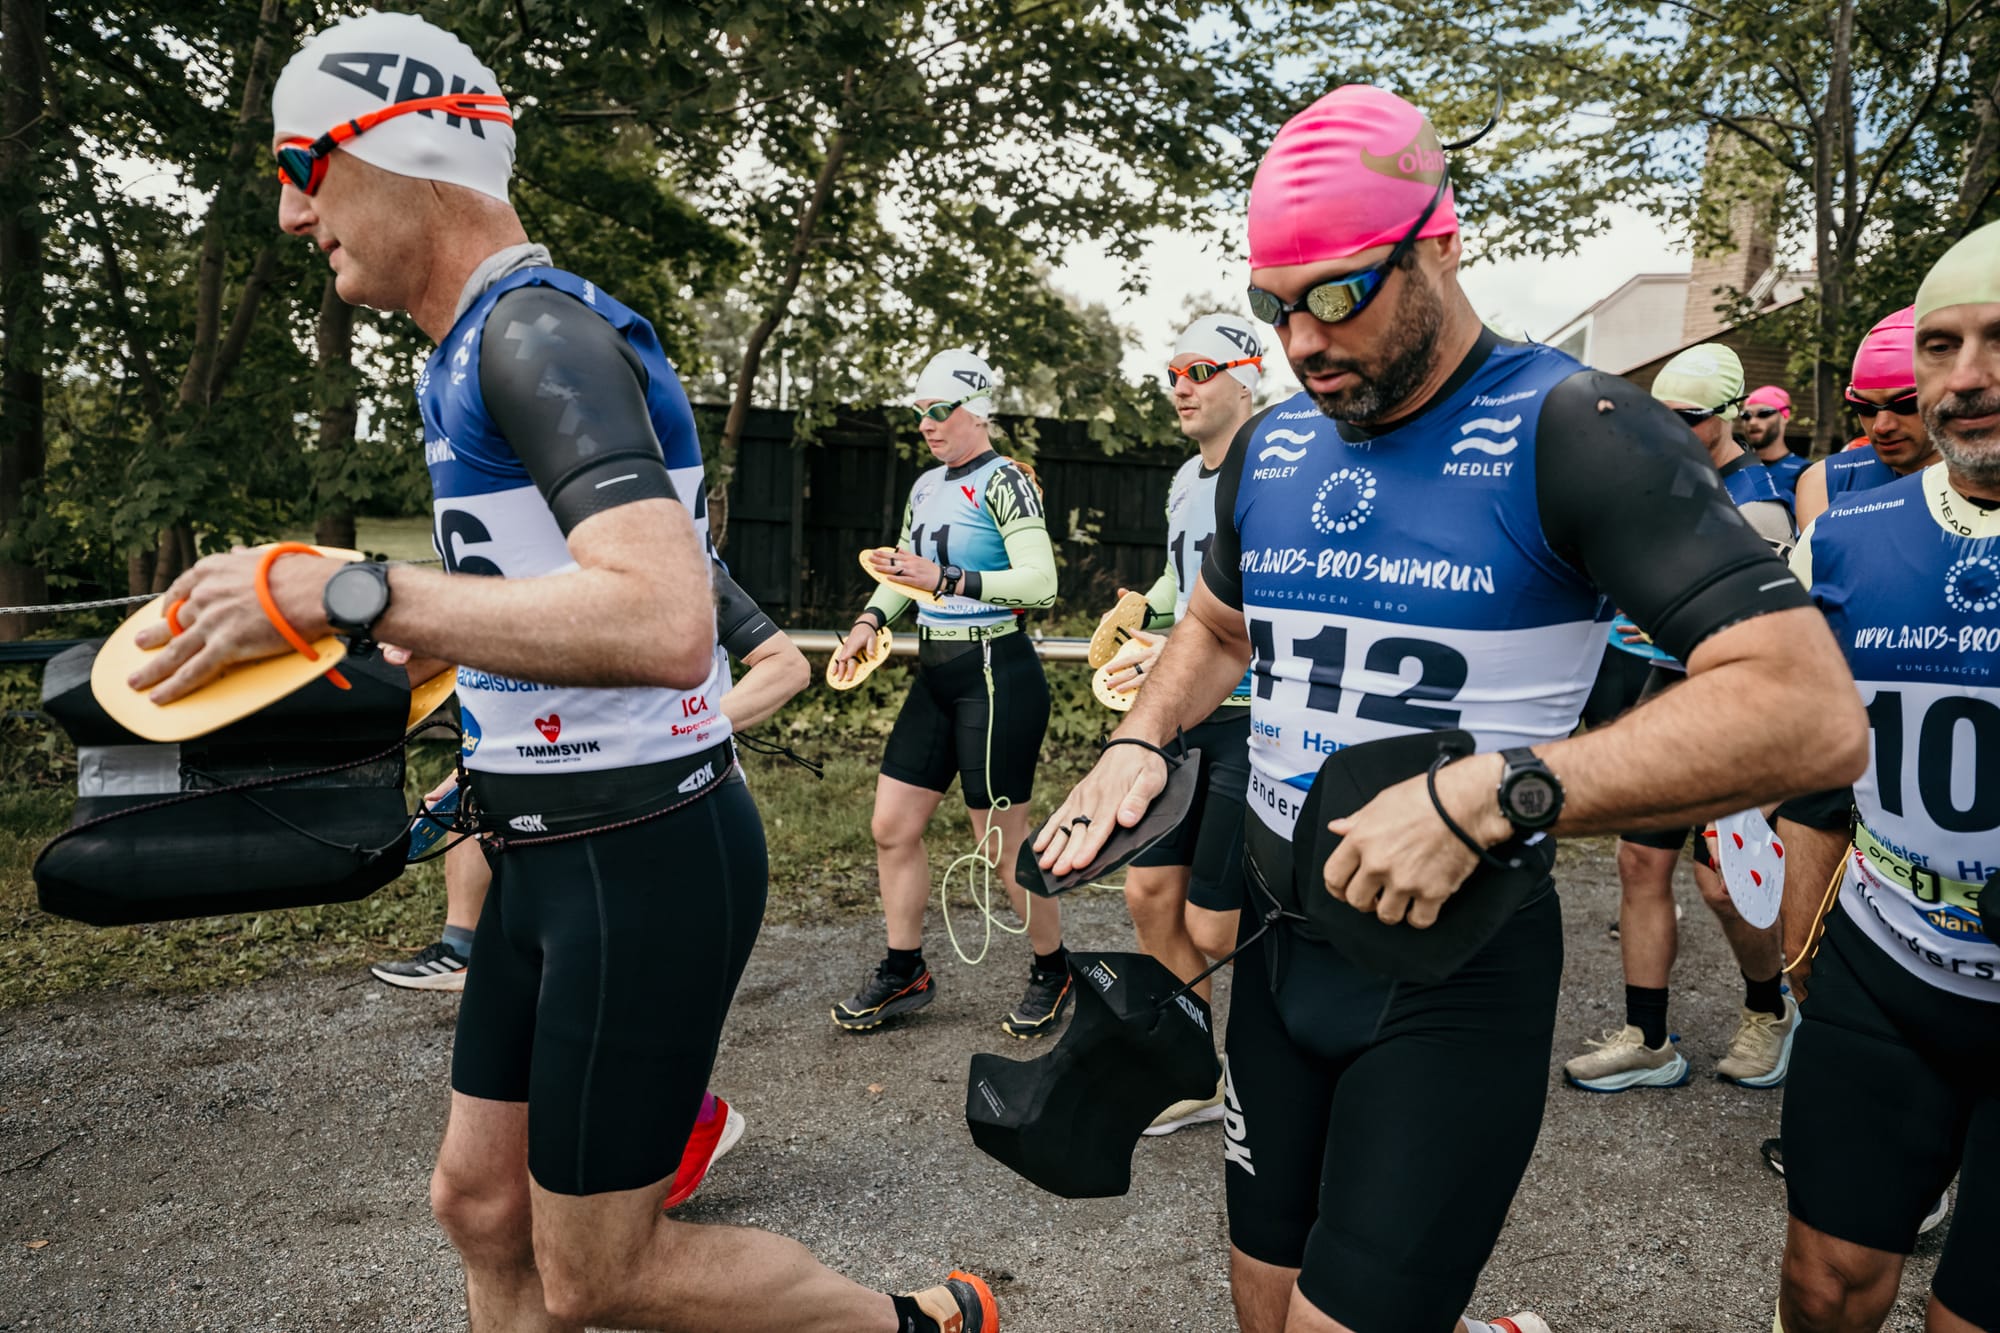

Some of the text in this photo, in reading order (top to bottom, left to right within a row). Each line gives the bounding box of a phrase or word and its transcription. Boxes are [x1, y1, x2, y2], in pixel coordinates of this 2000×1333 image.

[318, 52, 486, 140] ARK
[1216, 325, 1263, 357] AR
[953, 370, 992, 390] AR
[1253, 466, 1298, 480] MEDLEY
[1443, 462, 1514, 477] MEDLEY
[1831, 499, 1905, 518] Floristhörnan
[1940, 491, 1972, 536] HEAD
[1373, 600, 1408, 613] BRO
[682, 694, 708, 718] ICA
[516, 741, 601, 758] TAMMSVIK
[677, 760, 715, 794] ARK
[508, 814, 548, 832] ARK
[1088, 964, 1115, 992] keel
